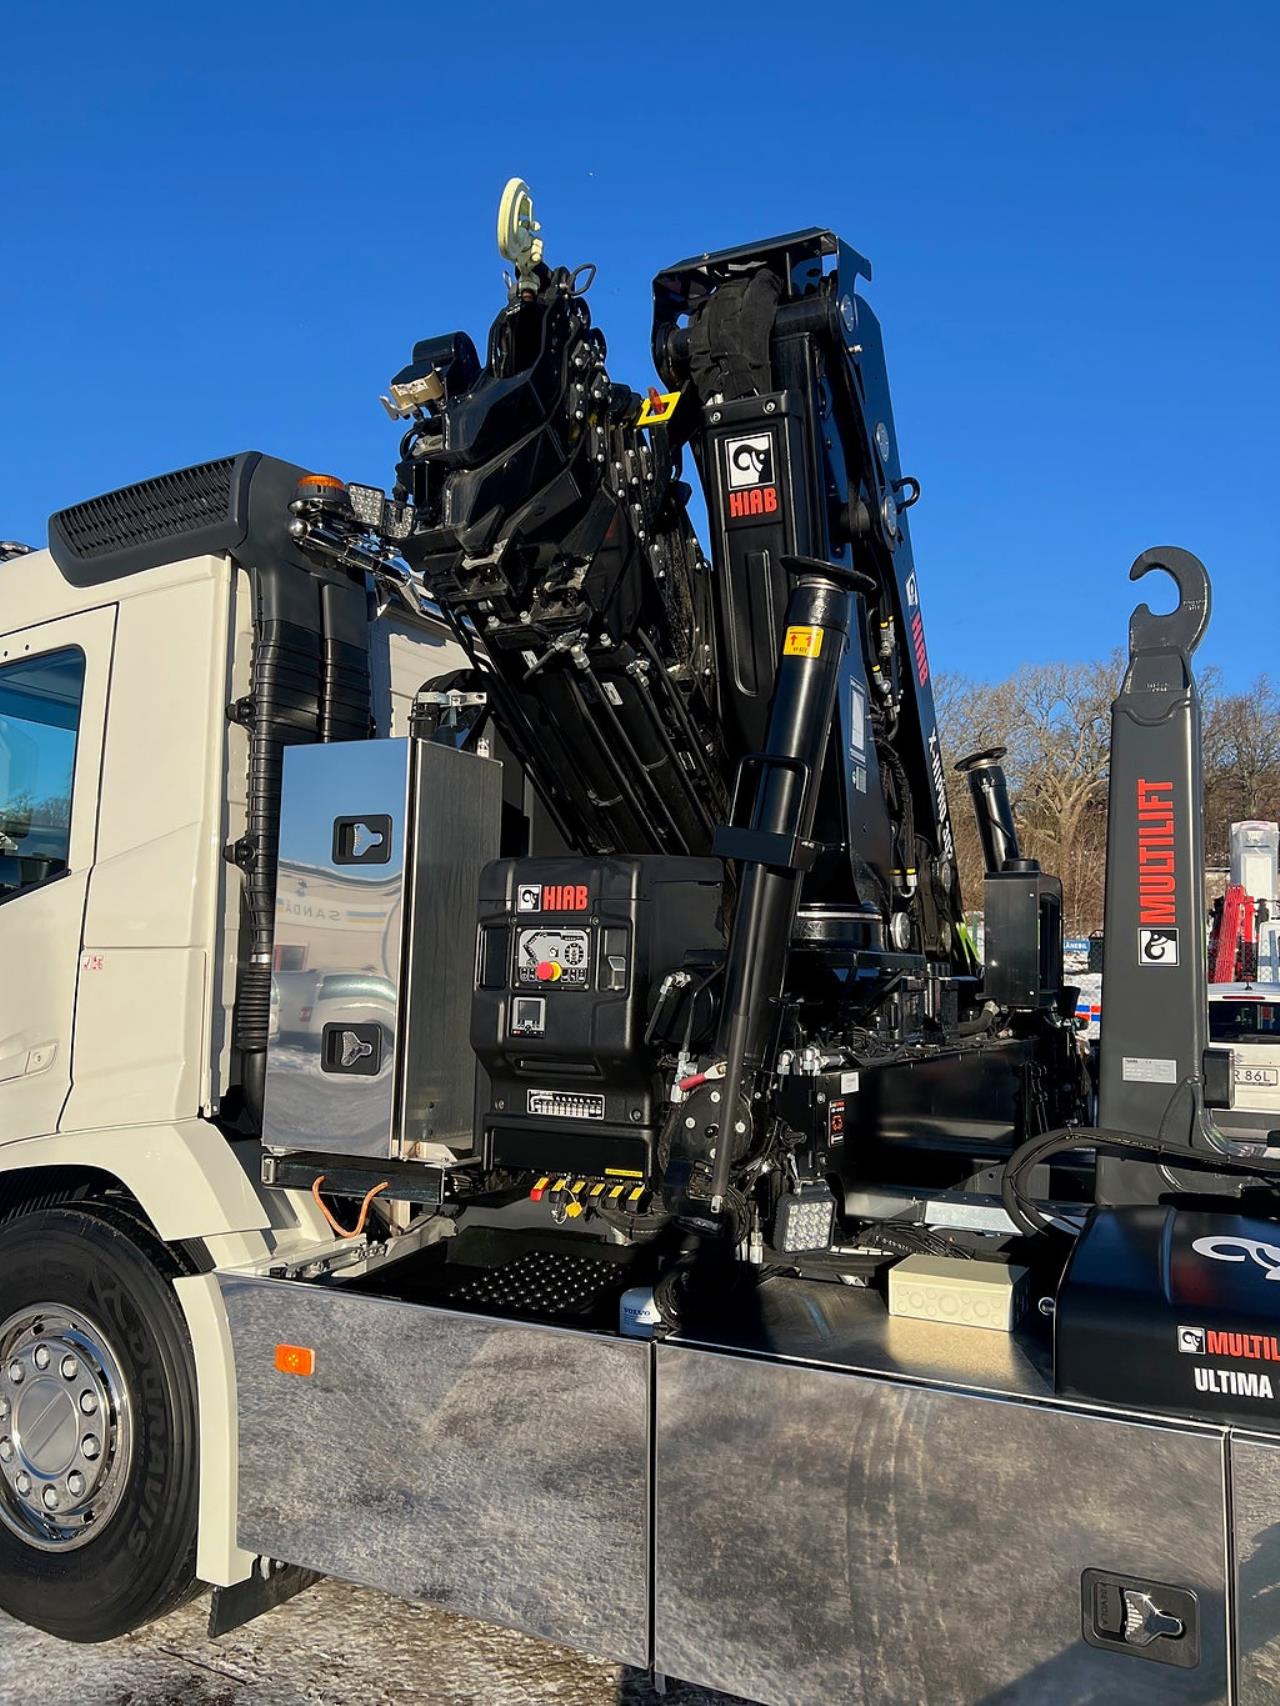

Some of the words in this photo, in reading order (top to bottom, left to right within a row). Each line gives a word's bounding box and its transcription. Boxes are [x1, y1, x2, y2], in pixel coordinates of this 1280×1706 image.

[729, 487, 777, 518] HIAB
[911, 611, 929, 688] HIAB
[1137, 778, 1176, 924] MULTILIFT
[543, 885, 589, 911] HIAB
[1245, 1070, 1271, 1082] 86L
[1194, 1367, 1275, 1399] ULTIMA
